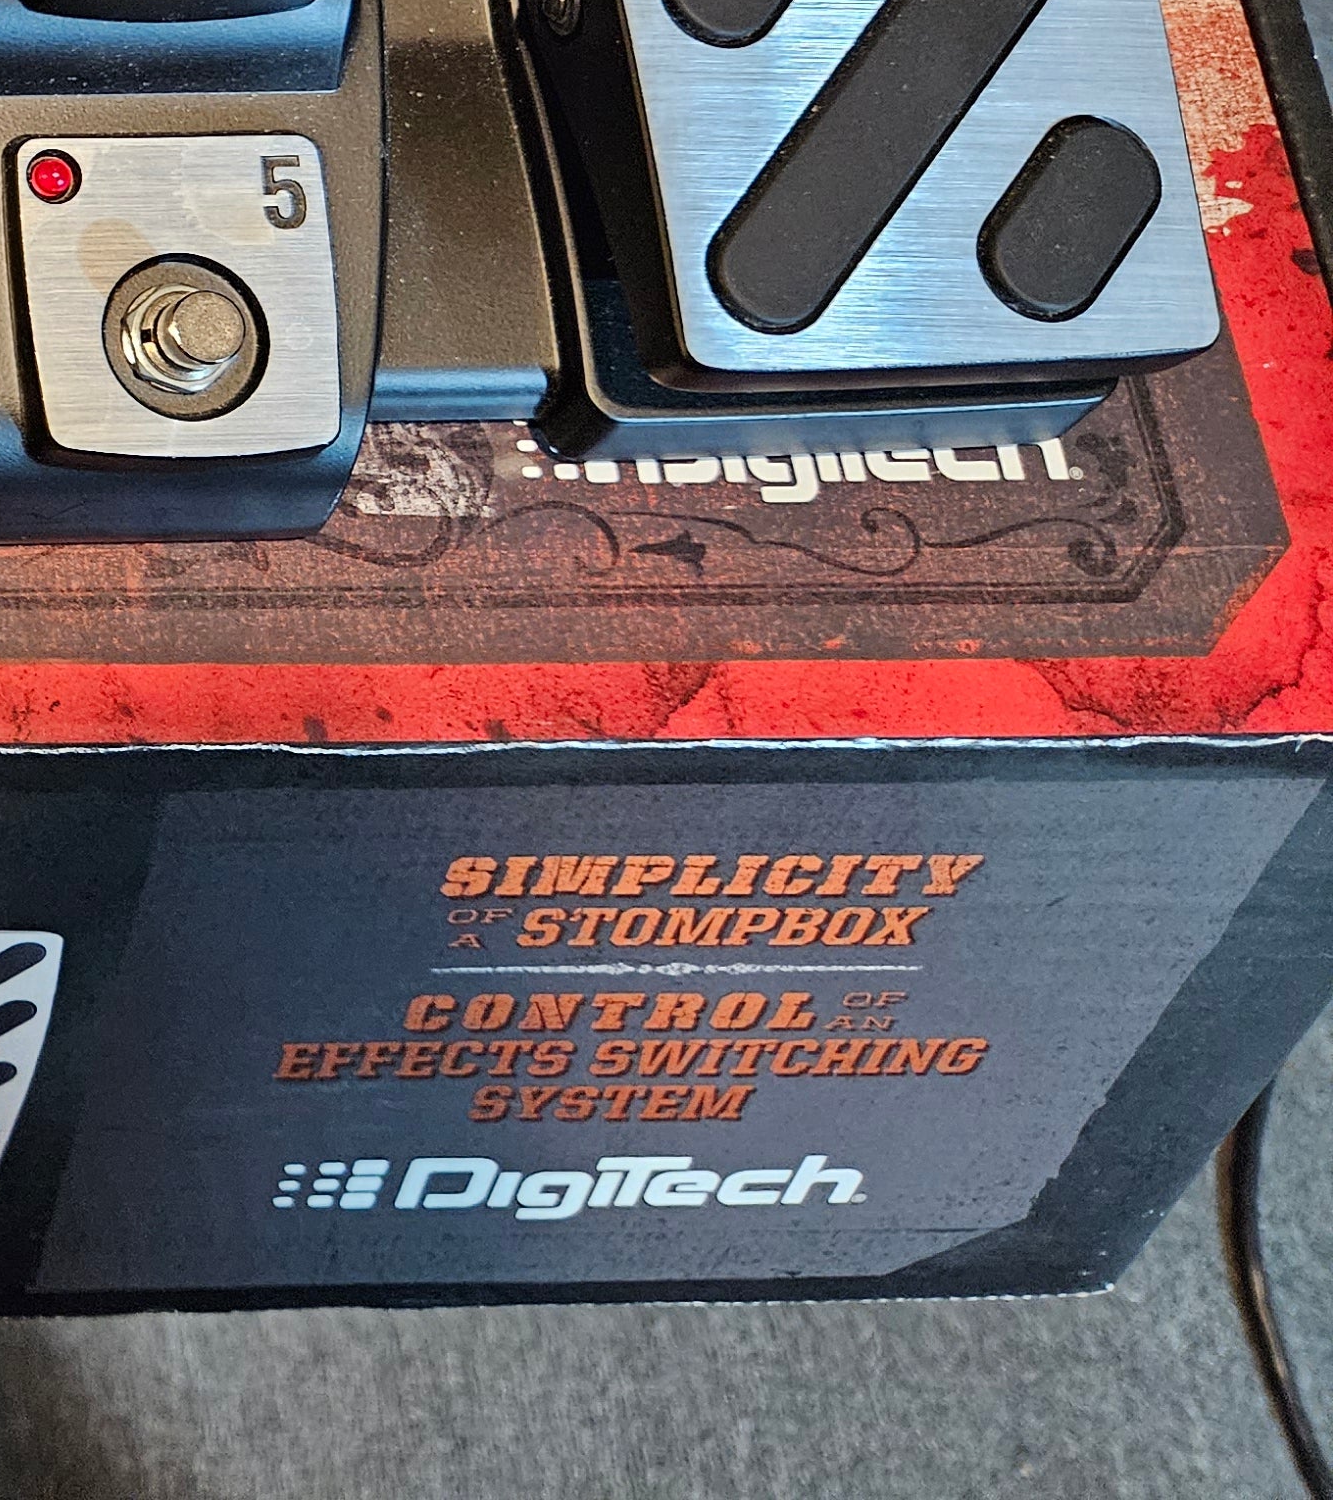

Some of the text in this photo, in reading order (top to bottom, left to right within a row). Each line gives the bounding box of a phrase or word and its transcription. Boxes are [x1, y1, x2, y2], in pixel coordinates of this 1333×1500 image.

[261, 155, 306, 229] 5
[440, 855, 984, 897] SIMPLICITY
[448, 934, 485, 949] A
[449, 907, 932, 947] OF STOMPBOX
[404, 992, 907, 1032] CONTROL OF
[823, 1016, 896, 1031] AN
[273, 1037, 989, 1079] EFFECTS SWITCHING
[468, 1085, 757, 1121] SYSTEM
[394, 1155, 865, 1221] DigiTech
